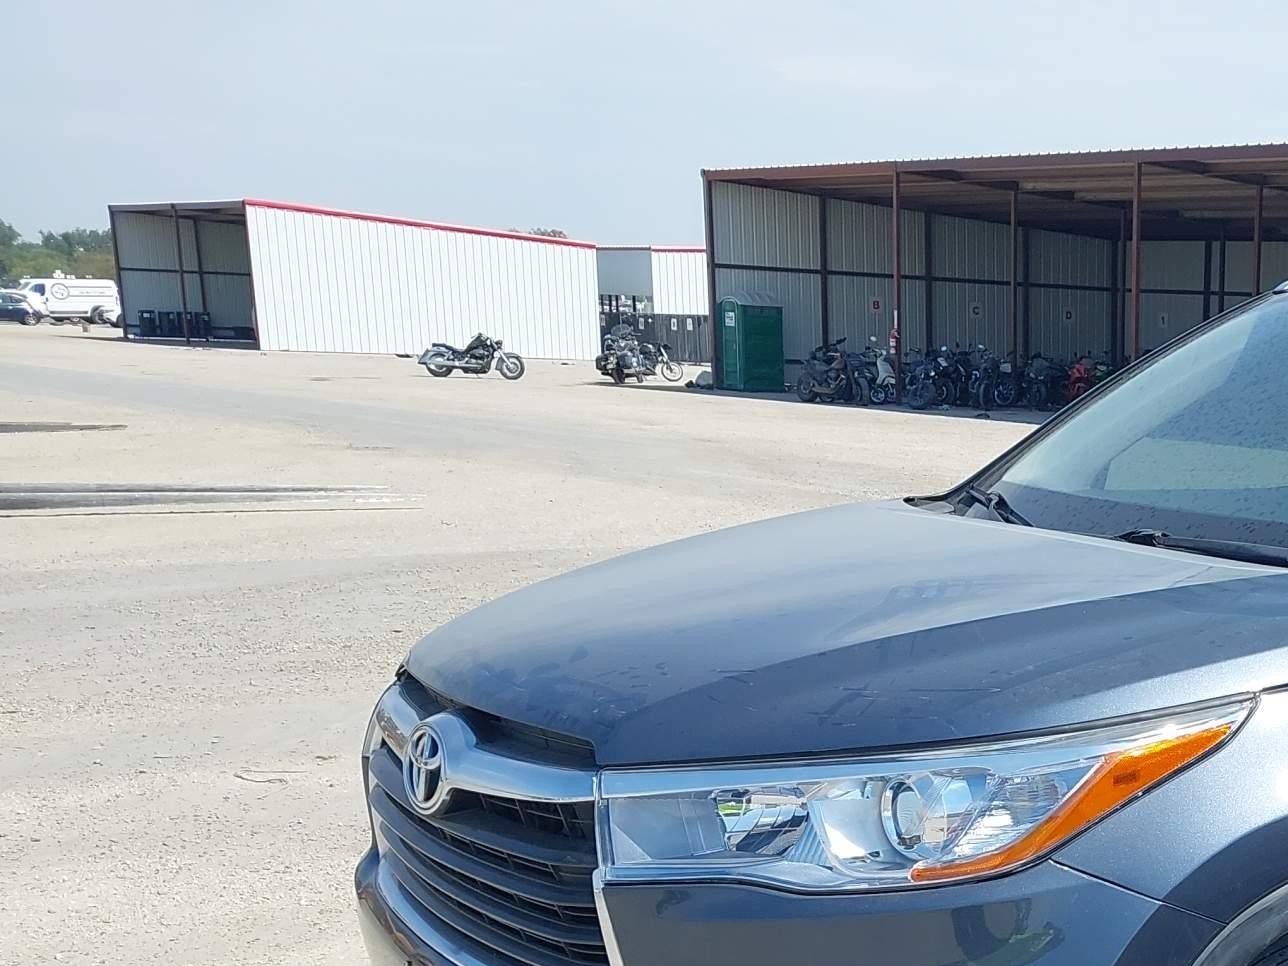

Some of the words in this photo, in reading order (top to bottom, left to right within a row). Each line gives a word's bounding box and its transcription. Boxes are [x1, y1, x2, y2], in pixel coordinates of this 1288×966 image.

[872, 300, 881, 310] B
[972, 306, 981, 316] C
[1064, 311, 1073, 320] D
